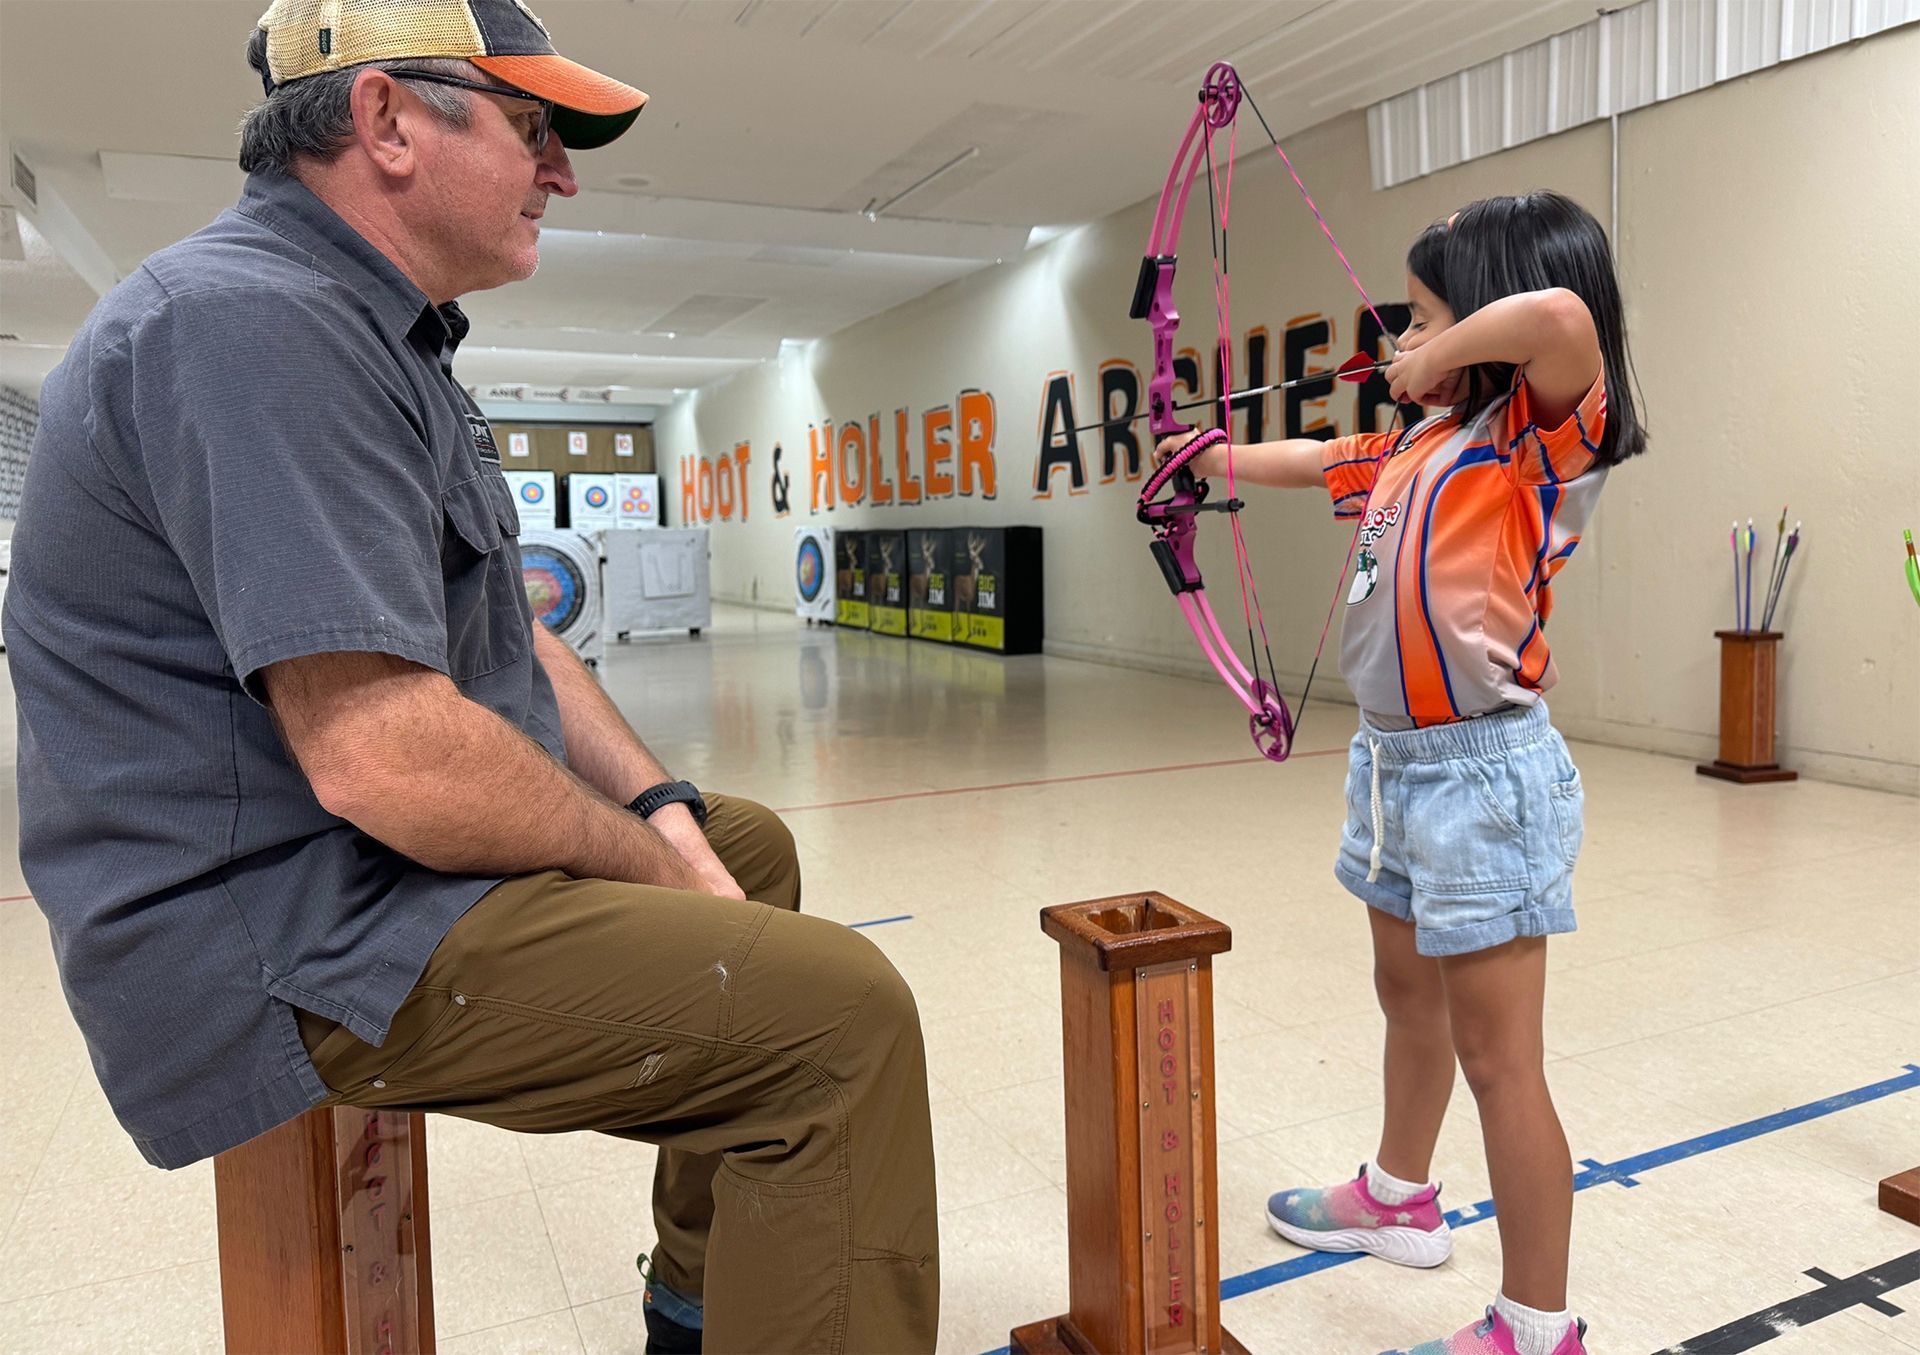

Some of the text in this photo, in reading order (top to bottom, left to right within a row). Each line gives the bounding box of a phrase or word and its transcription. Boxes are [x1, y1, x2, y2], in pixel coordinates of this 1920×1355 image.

[680, 440, 750, 526] HOOT
[772, 443, 790, 518] &
[808, 389, 997, 515] HOLLER
[929, 573, 944, 590] BIG
[977, 574, 995, 592] BIG
[928, 589, 944, 605] JIM
[977, 591, 995, 609] JIM
[1158, 999, 1184, 1328] HOOT & HOLLER
